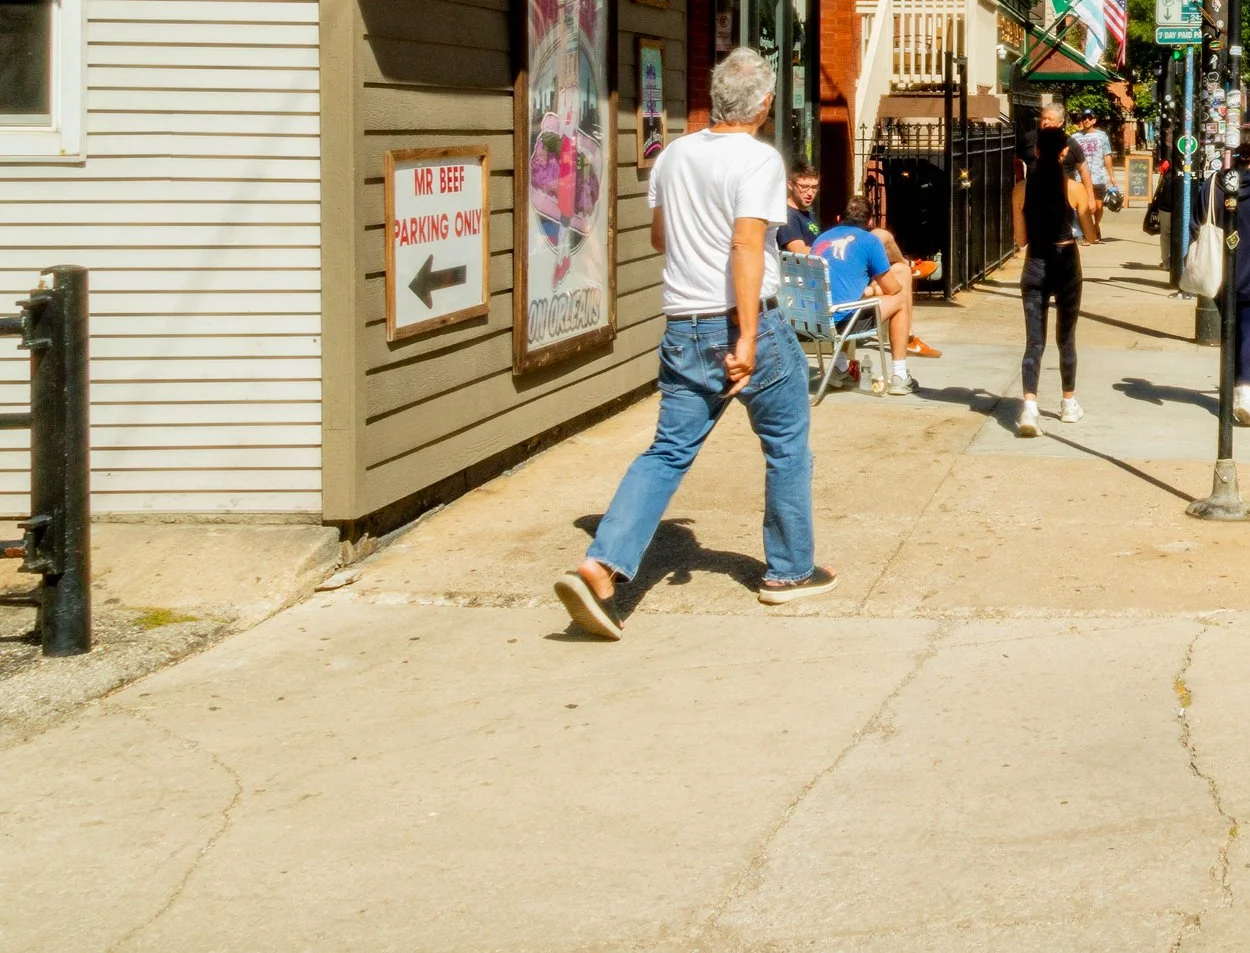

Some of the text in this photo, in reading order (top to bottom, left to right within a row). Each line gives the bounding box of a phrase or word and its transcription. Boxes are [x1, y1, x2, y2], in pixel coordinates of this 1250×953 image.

[1164, 31, 1177, 39] DAY
[1178, 31, 1193, 39] PAID
[414, 166, 464, 196] MR BEEF
[394, 208, 482, 246] PARKING ONLY
